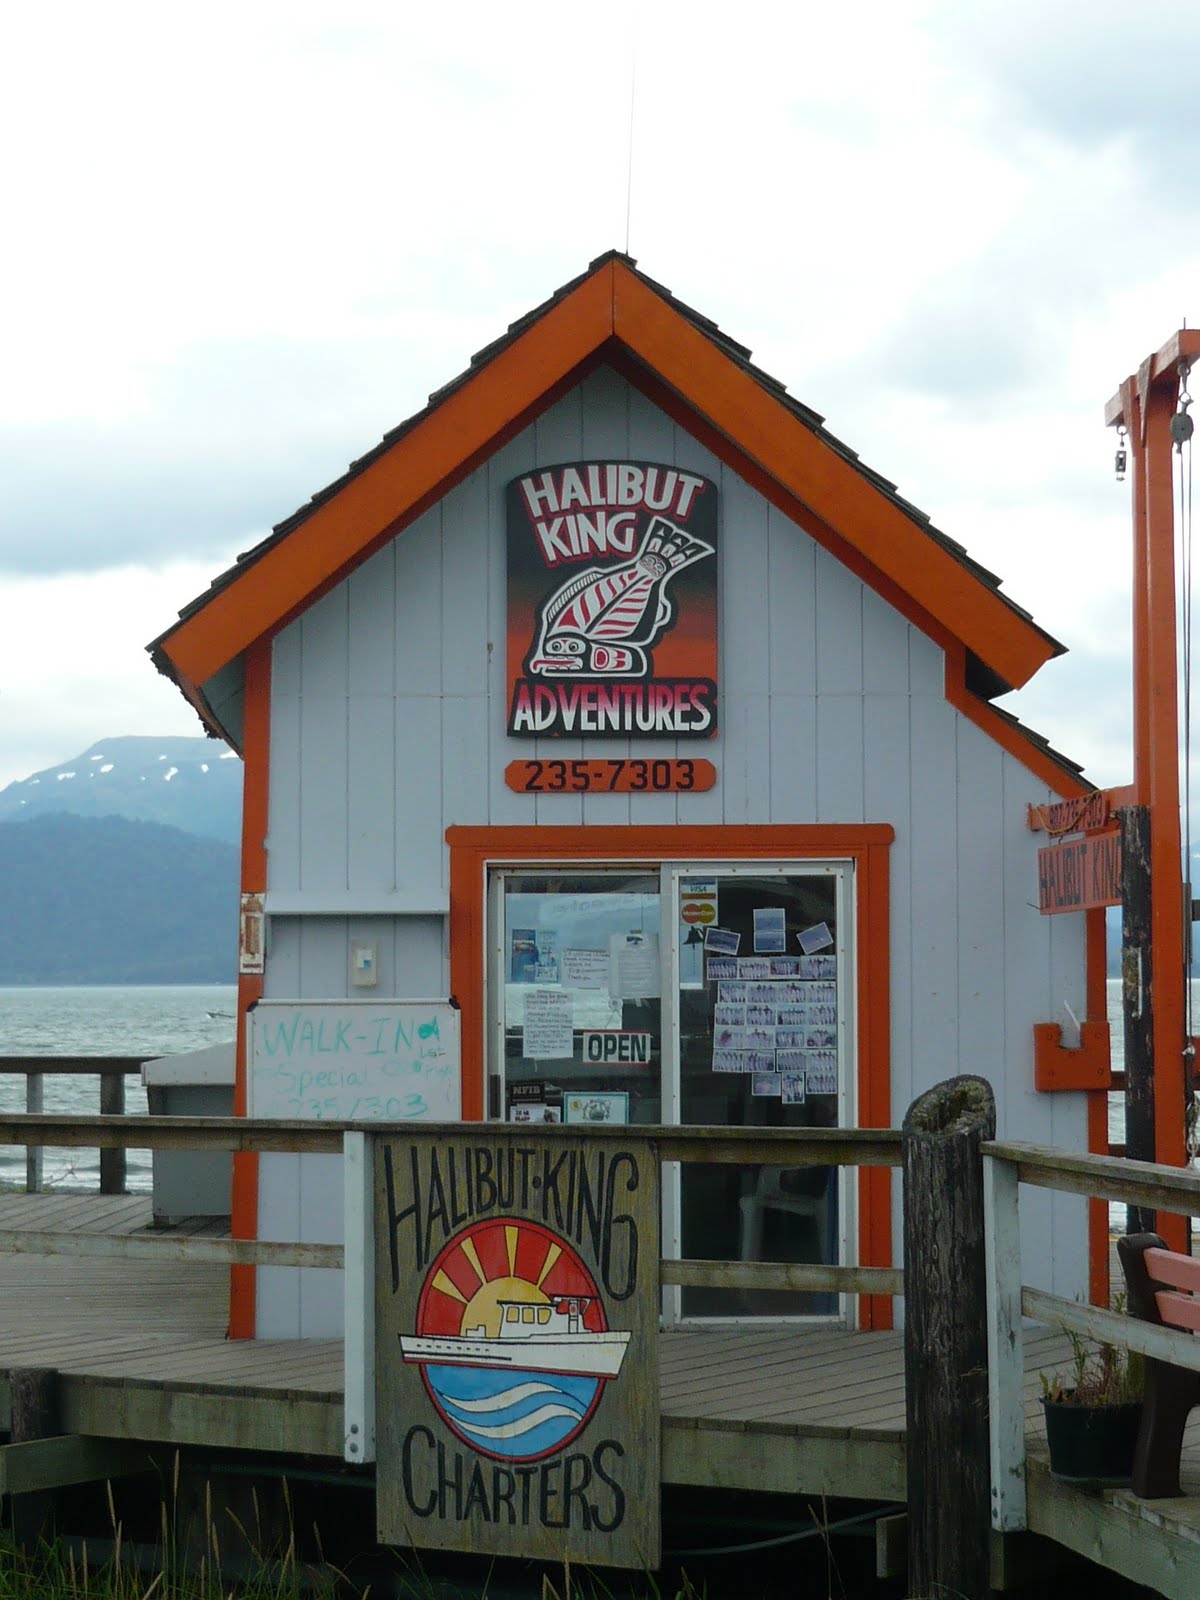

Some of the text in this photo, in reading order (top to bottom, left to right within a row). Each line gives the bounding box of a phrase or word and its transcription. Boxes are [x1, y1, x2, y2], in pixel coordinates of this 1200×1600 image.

[520, 464, 704, 519] HALIBUT
[536, 511, 637, 562] KING
[513, 684, 712, 732] ADVENTURES
[525, 760, 696, 791] 235-7303
[1038, 842, 1087, 909] HALIBUT
[587, 1034, 647, 1062] OPEN
[275, 1061, 368, 1098] Special
[542, 1147, 639, 1301] KING
[402, 1424, 626, 1533] CHARTERS
